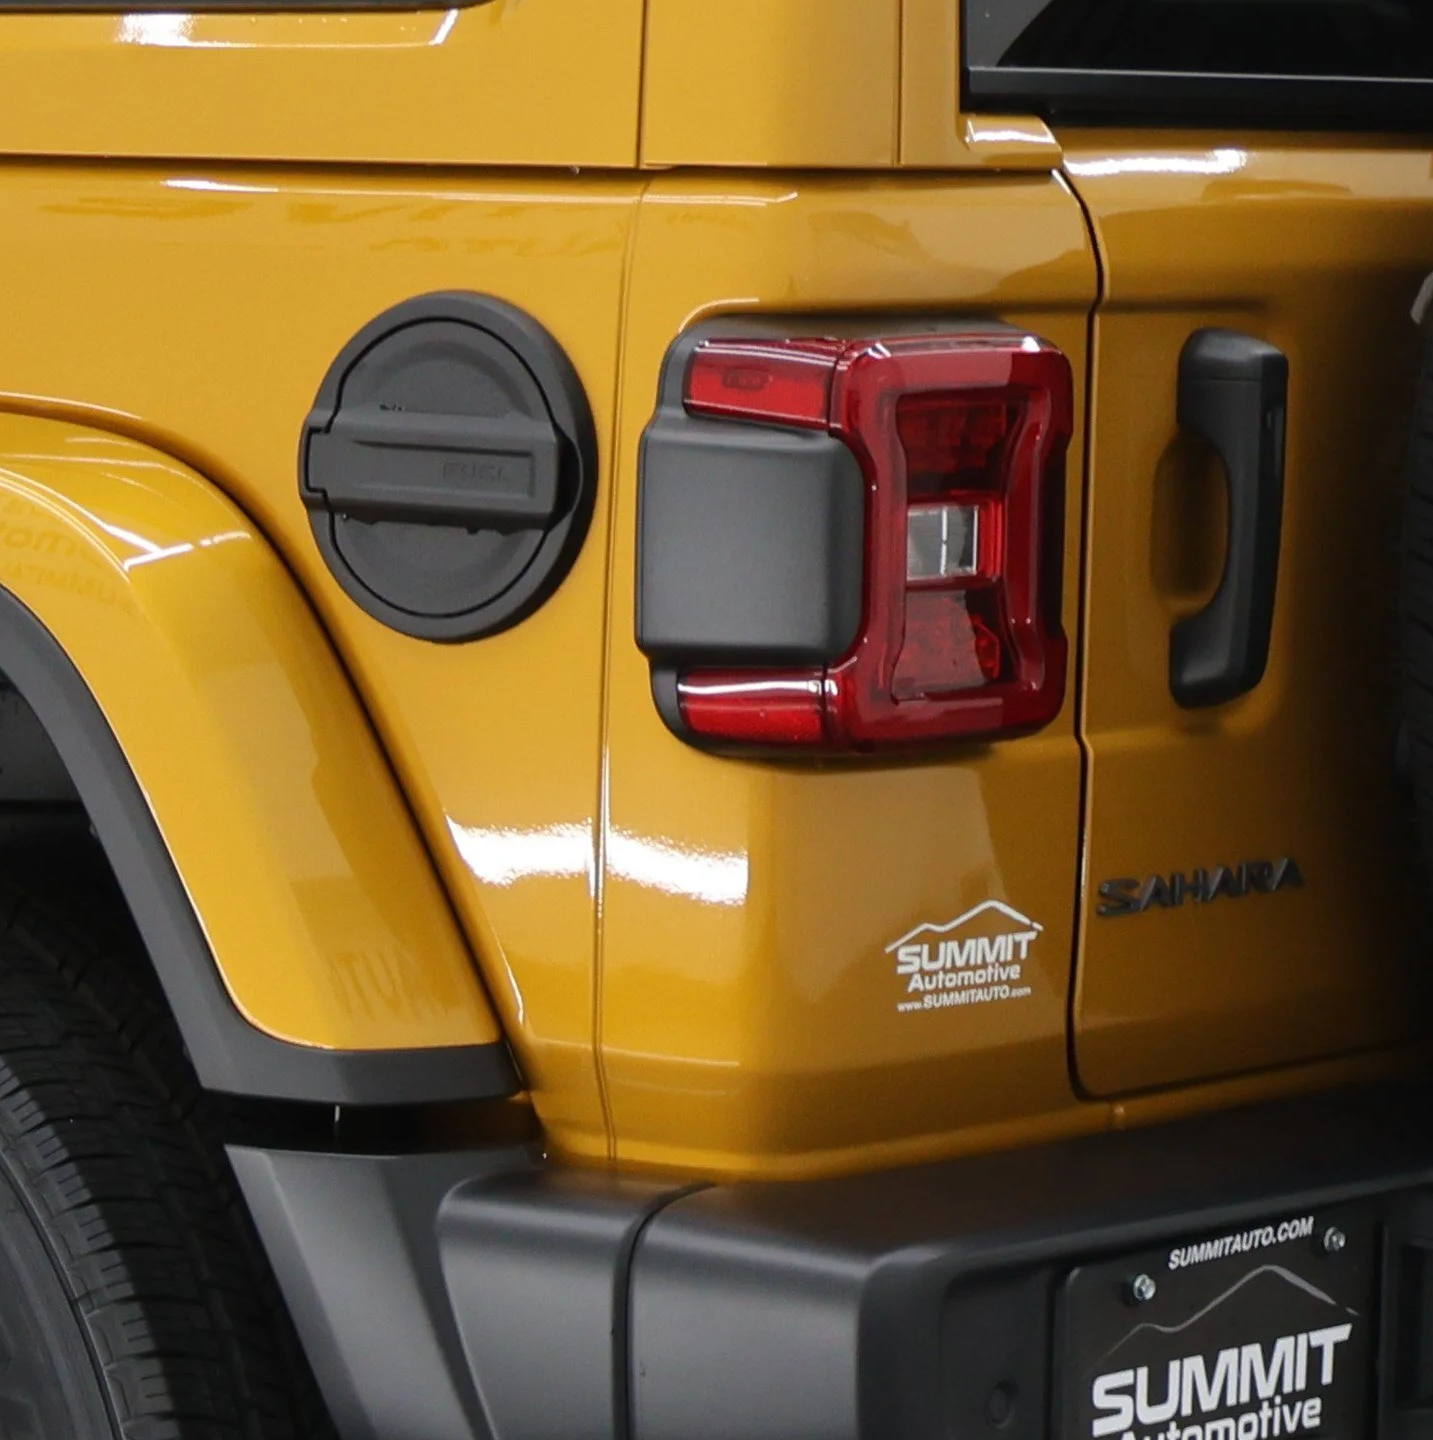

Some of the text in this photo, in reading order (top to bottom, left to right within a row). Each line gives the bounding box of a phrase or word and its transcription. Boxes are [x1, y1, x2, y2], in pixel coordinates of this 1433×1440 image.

[1095, 856, 1305, 917] SAHARA
[896, 930, 1038, 975] SUMMIT
[907, 962, 1021, 993] Automotive
[896, 984, 1032, 1013] www.SUMMITAUTO.com
[1168, 1215, 1315, 1271] SUMMITAUTO.COM
[1092, 1323, 1352, 1438] SUMMIT
